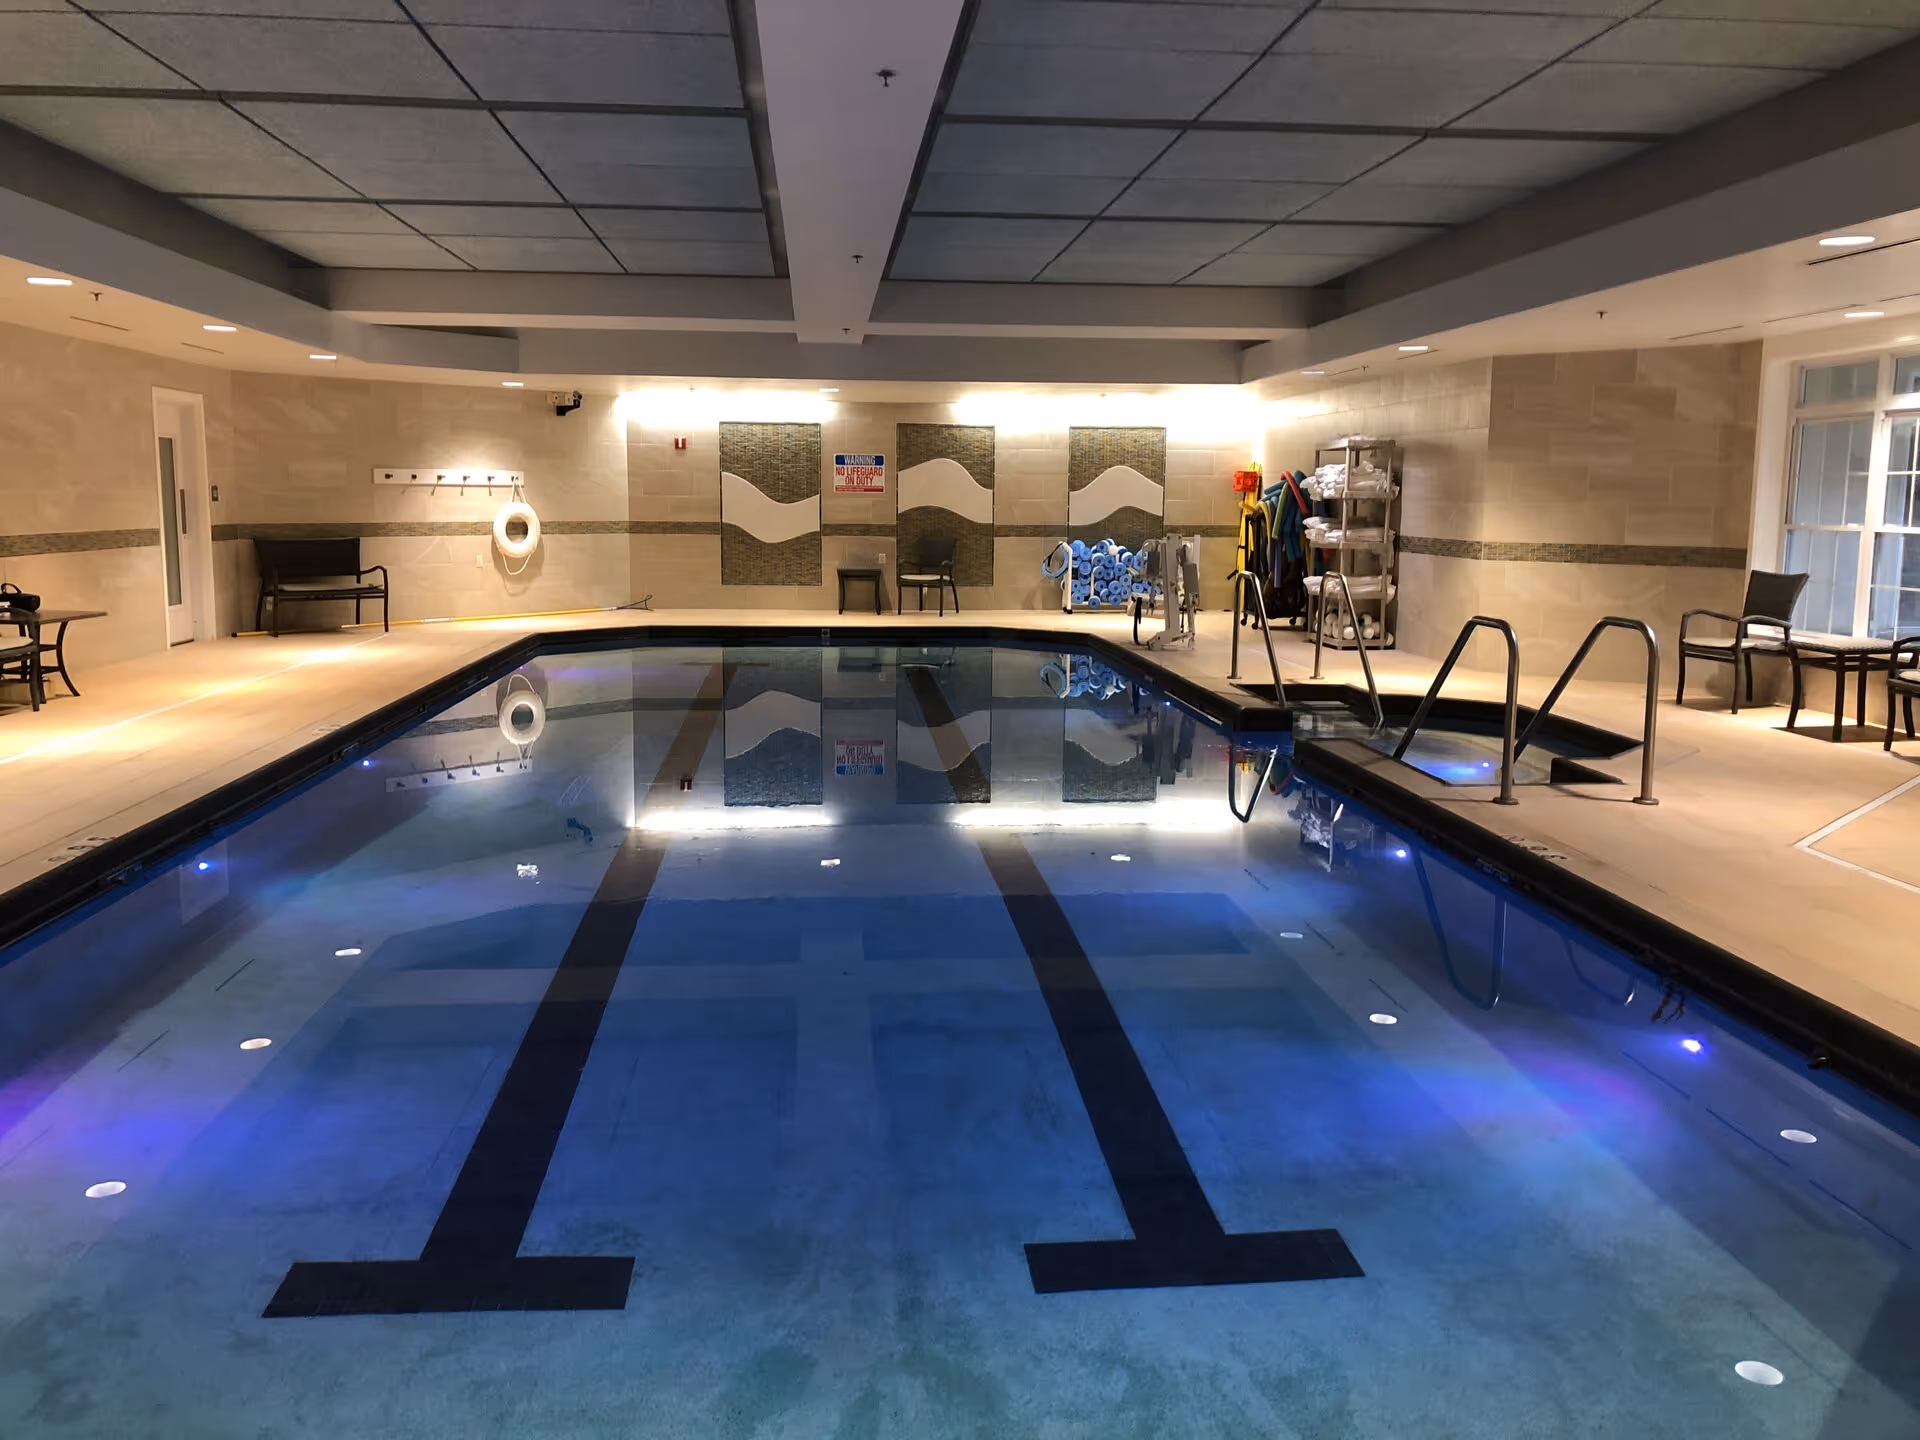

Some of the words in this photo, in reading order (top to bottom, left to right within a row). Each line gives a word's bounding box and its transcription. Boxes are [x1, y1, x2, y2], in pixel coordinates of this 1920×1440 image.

[844, 455, 876, 465] WARNING
[836, 466, 845, 476] NO
[847, 466, 883, 476] LIFEGUARD
[845, 476, 855, 485] ON
[856, 476, 874, 485] DUTY
